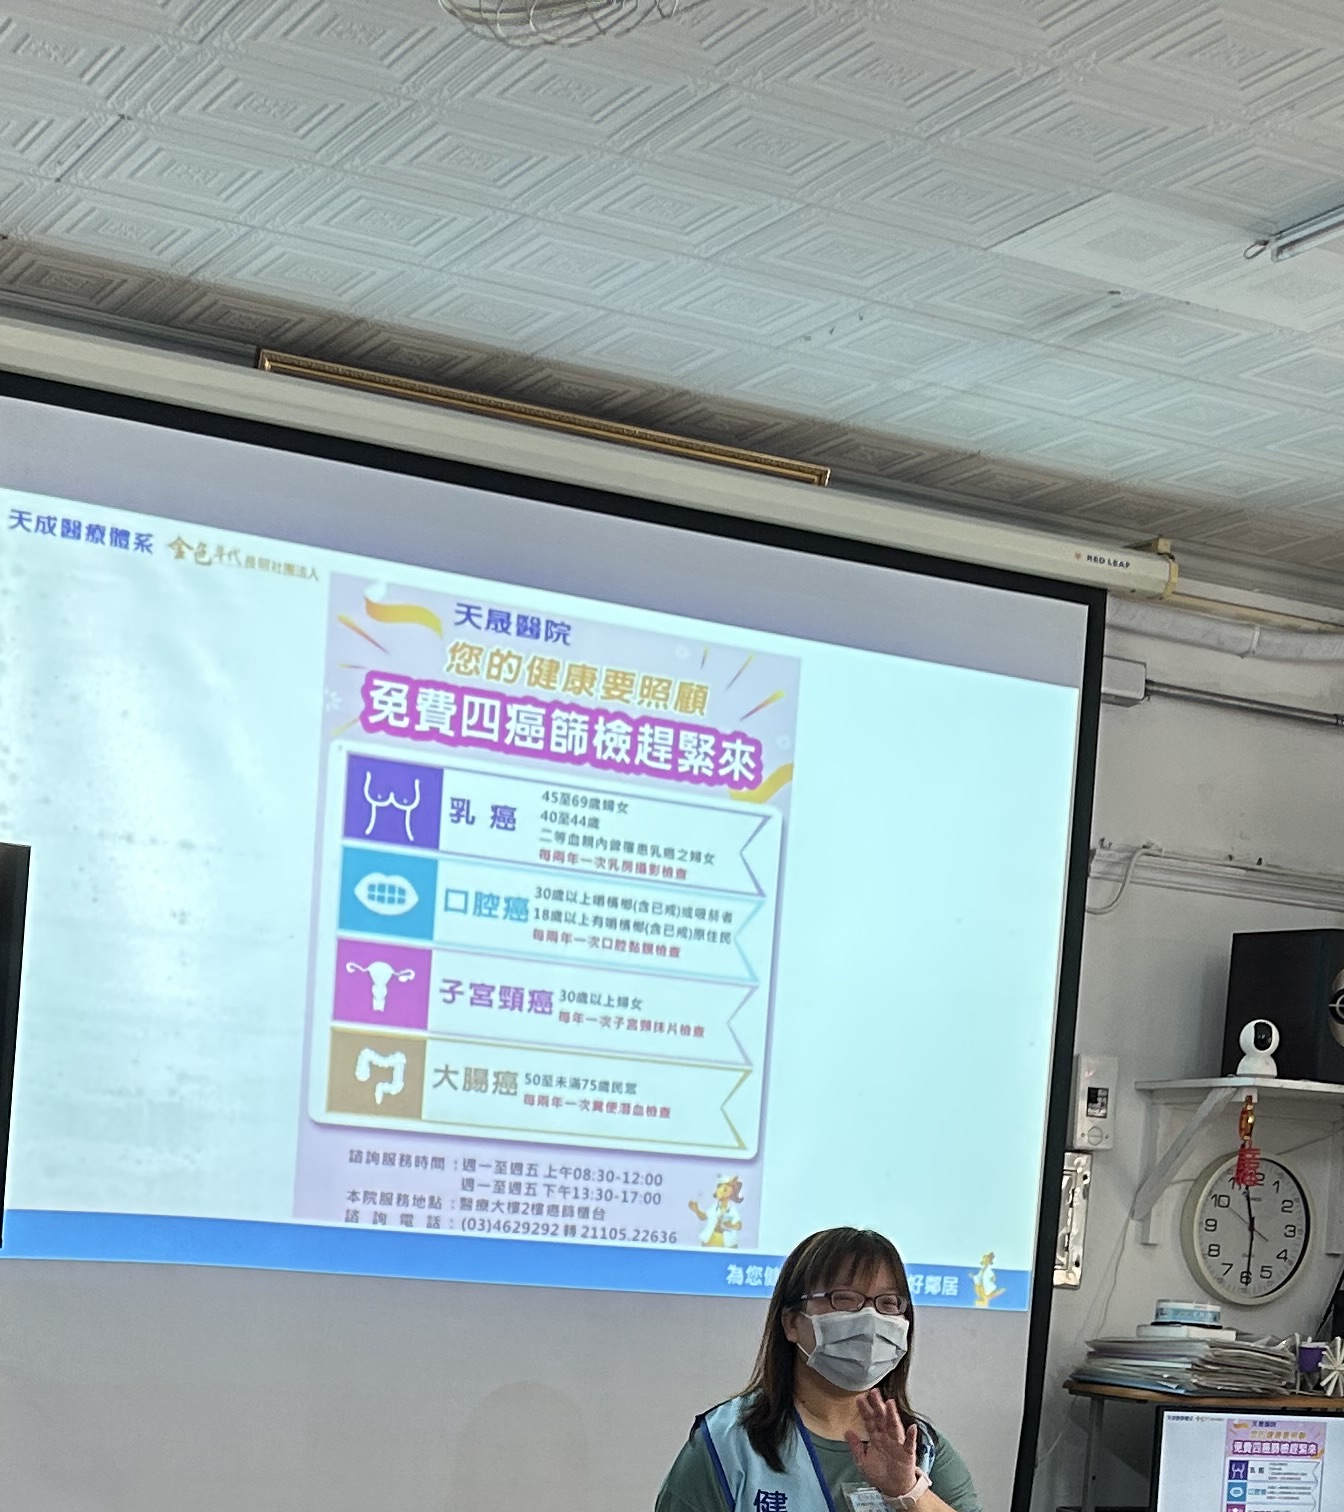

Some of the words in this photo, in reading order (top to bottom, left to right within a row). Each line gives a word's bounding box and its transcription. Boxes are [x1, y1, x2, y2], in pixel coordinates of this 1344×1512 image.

[7, 508, 153, 553] 天成醫療體系
[454, 602, 572, 646] 天晟醫院
[445, 640, 711, 717] 您的健康要照顧
[367, 676, 759, 783] 免費四癌篩檢趕緊來
[443, 888, 530, 924] 口腔癌
[439, 977, 554, 1016] 子宮頸癌
[433, 1063, 519, 1097] 大腸癌
[1211, 1194, 1231, 1208] 10
[1281, 1200, 1294, 1213] 2
[1205, 1218, 1218, 1232] 9
[1284, 1224, 1297, 1238] 3
[1207, 1244, 1221, 1257] 8
[1276, 1249, 1288, 1262] 4
[1221, 1263, 1234, 1276] 7
[1260, 1265, 1273, 1279] 5
